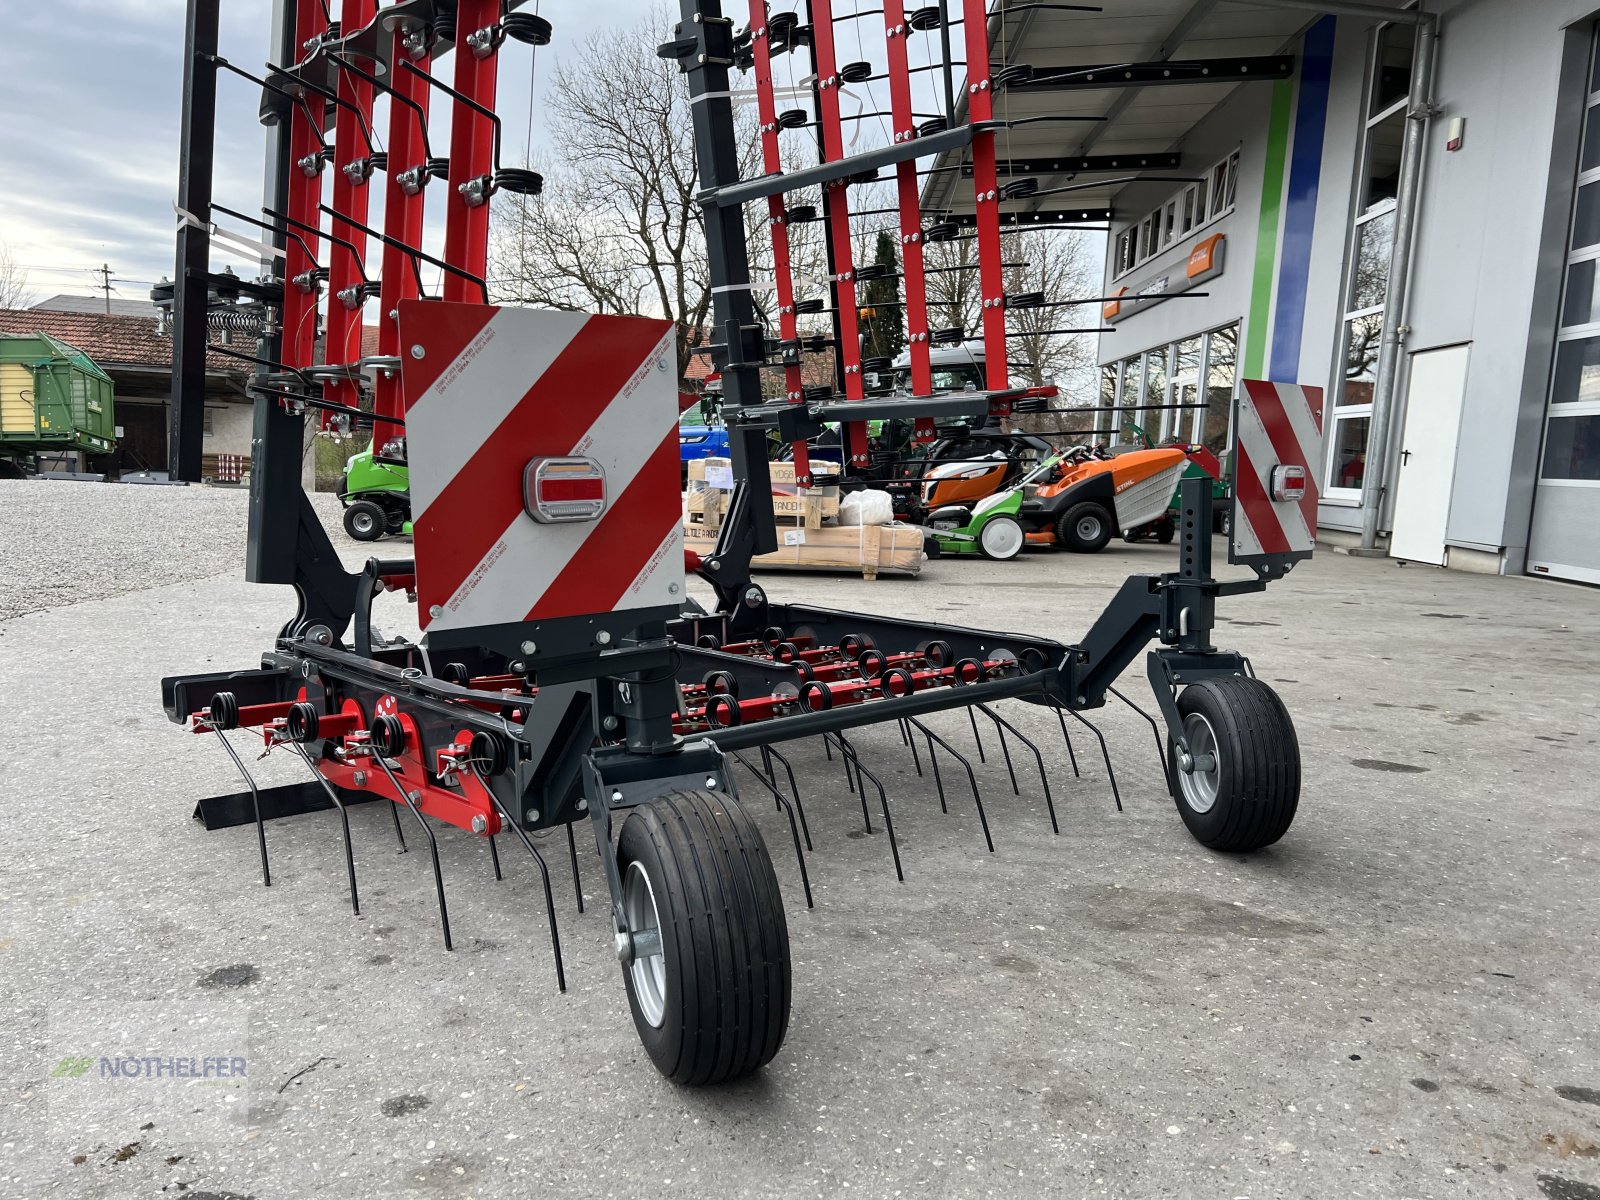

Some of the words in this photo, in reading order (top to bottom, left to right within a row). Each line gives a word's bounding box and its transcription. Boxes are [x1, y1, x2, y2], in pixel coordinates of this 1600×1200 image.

[457, 359, 470, 373] GEKA
[1116, 479, 1135, 492] STIHL
[473, 562, 486, 576] GEKA
[451, 602, 460, 612] DIN
[470, 574, 482, 589] GEKA
